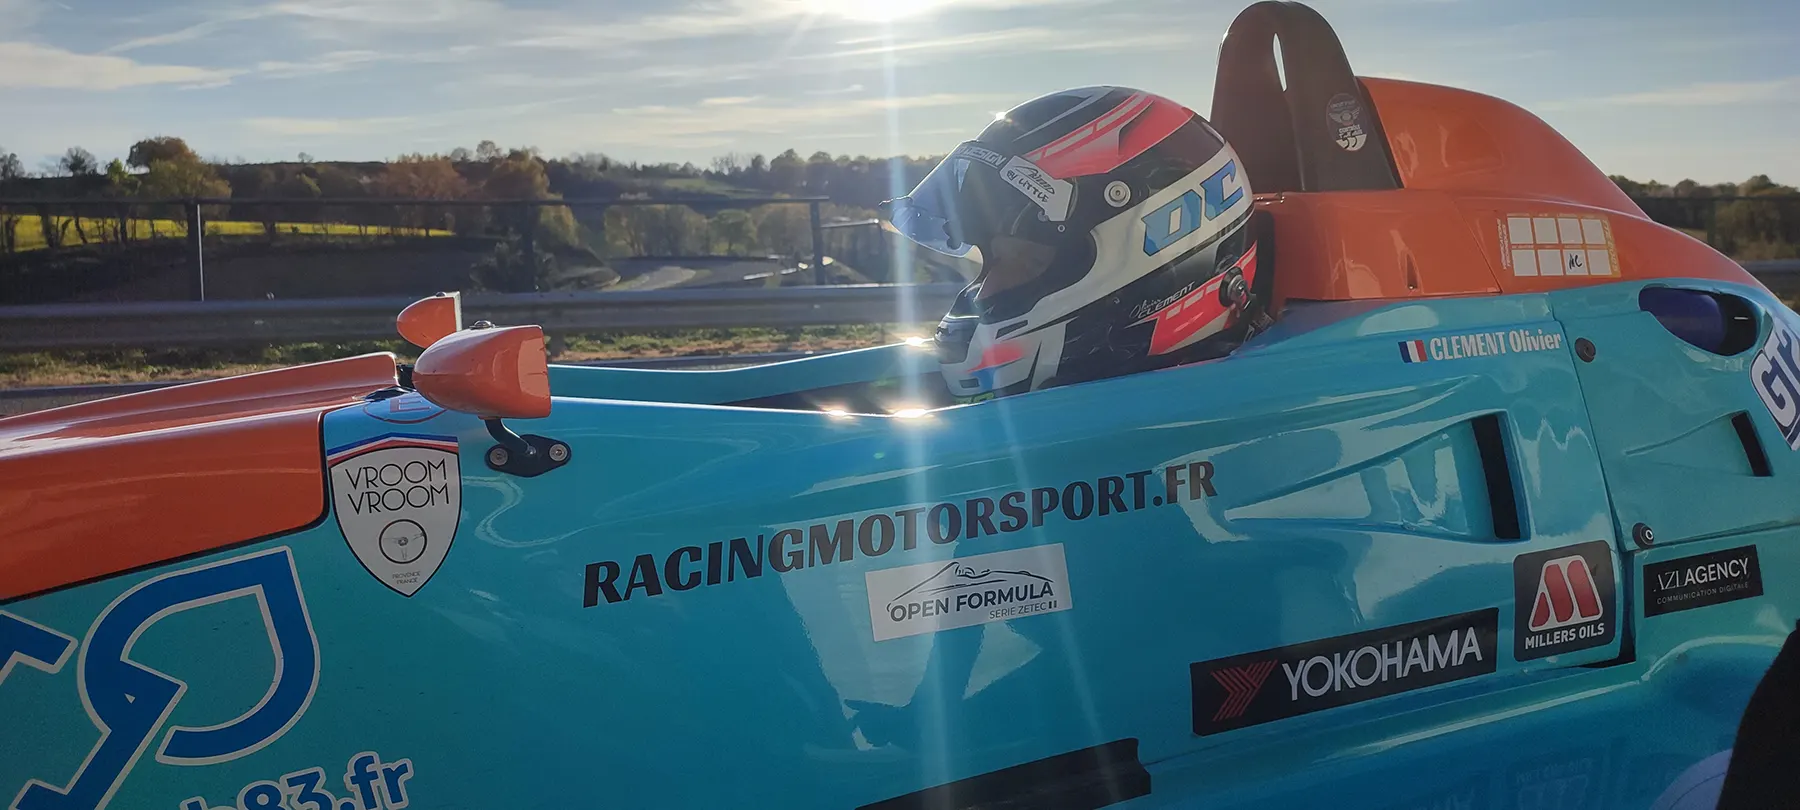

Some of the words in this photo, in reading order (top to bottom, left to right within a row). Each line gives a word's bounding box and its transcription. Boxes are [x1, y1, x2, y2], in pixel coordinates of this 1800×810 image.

[1137, 280, 1196, 319] CLEMENT
[1429, 332, 1507, 361] CLEMENT
[1508, 328, 1562, 353] Olivier
[344, 458, 448, 490] VROOM
[347, 482, 450, 515] VROOM
[582, 460, 1218, 609] RACINGMOTORSPORT.FR
[889, 597, 950, 623] OPEN
[955, 581, 1055, 612] FORMULA
[989, 607, 1016, 620] SERIE
[1017, 601, 1047, 615] ZETEC
[1656, 587, 1718, 605] COMMUNICATION
[1524, 628, 1577, 650] MILLERS
[1578, 622, 1605, 641] OILS
[1281, 626, 1483, 701] YOKOHAMA
